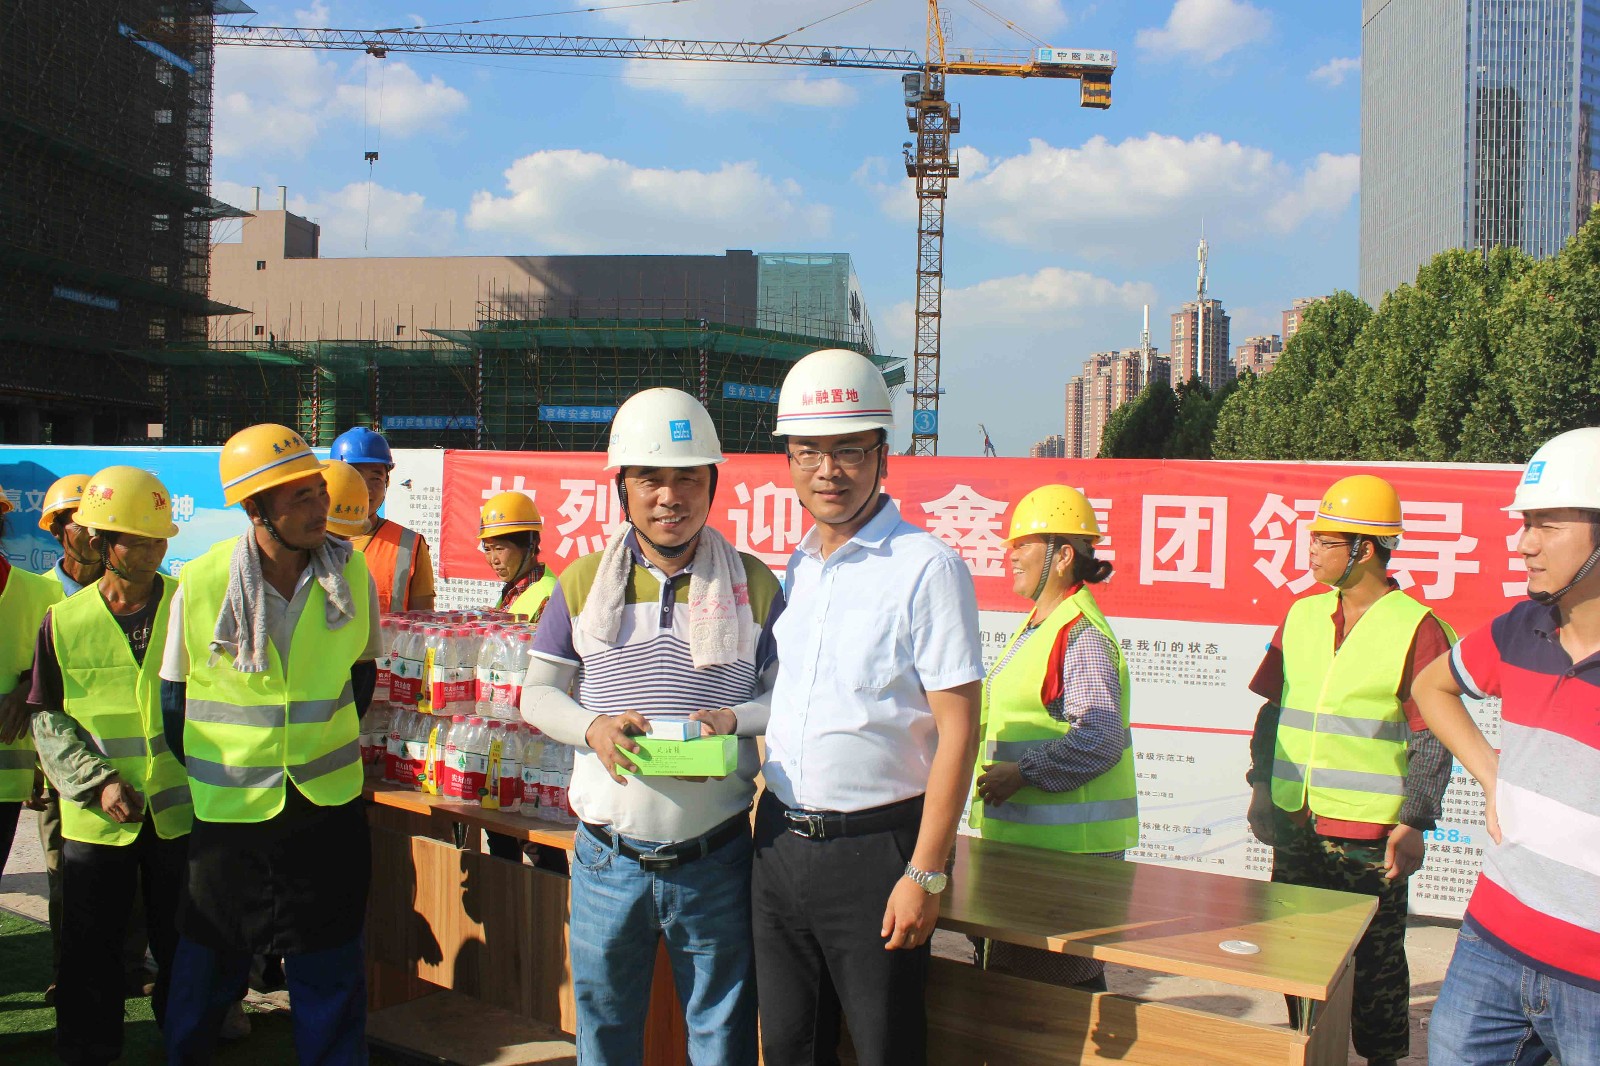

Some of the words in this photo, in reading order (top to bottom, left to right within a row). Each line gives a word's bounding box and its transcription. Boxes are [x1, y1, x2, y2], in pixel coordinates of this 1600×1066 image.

[979, 630, 1014, 643] 们的
[1120, 638, 1219, 655] 是我们的状态
[1135, 751, 1196, 764] 省级示范工地
[1138, 821, 1213, 836] 标准化示范工地
